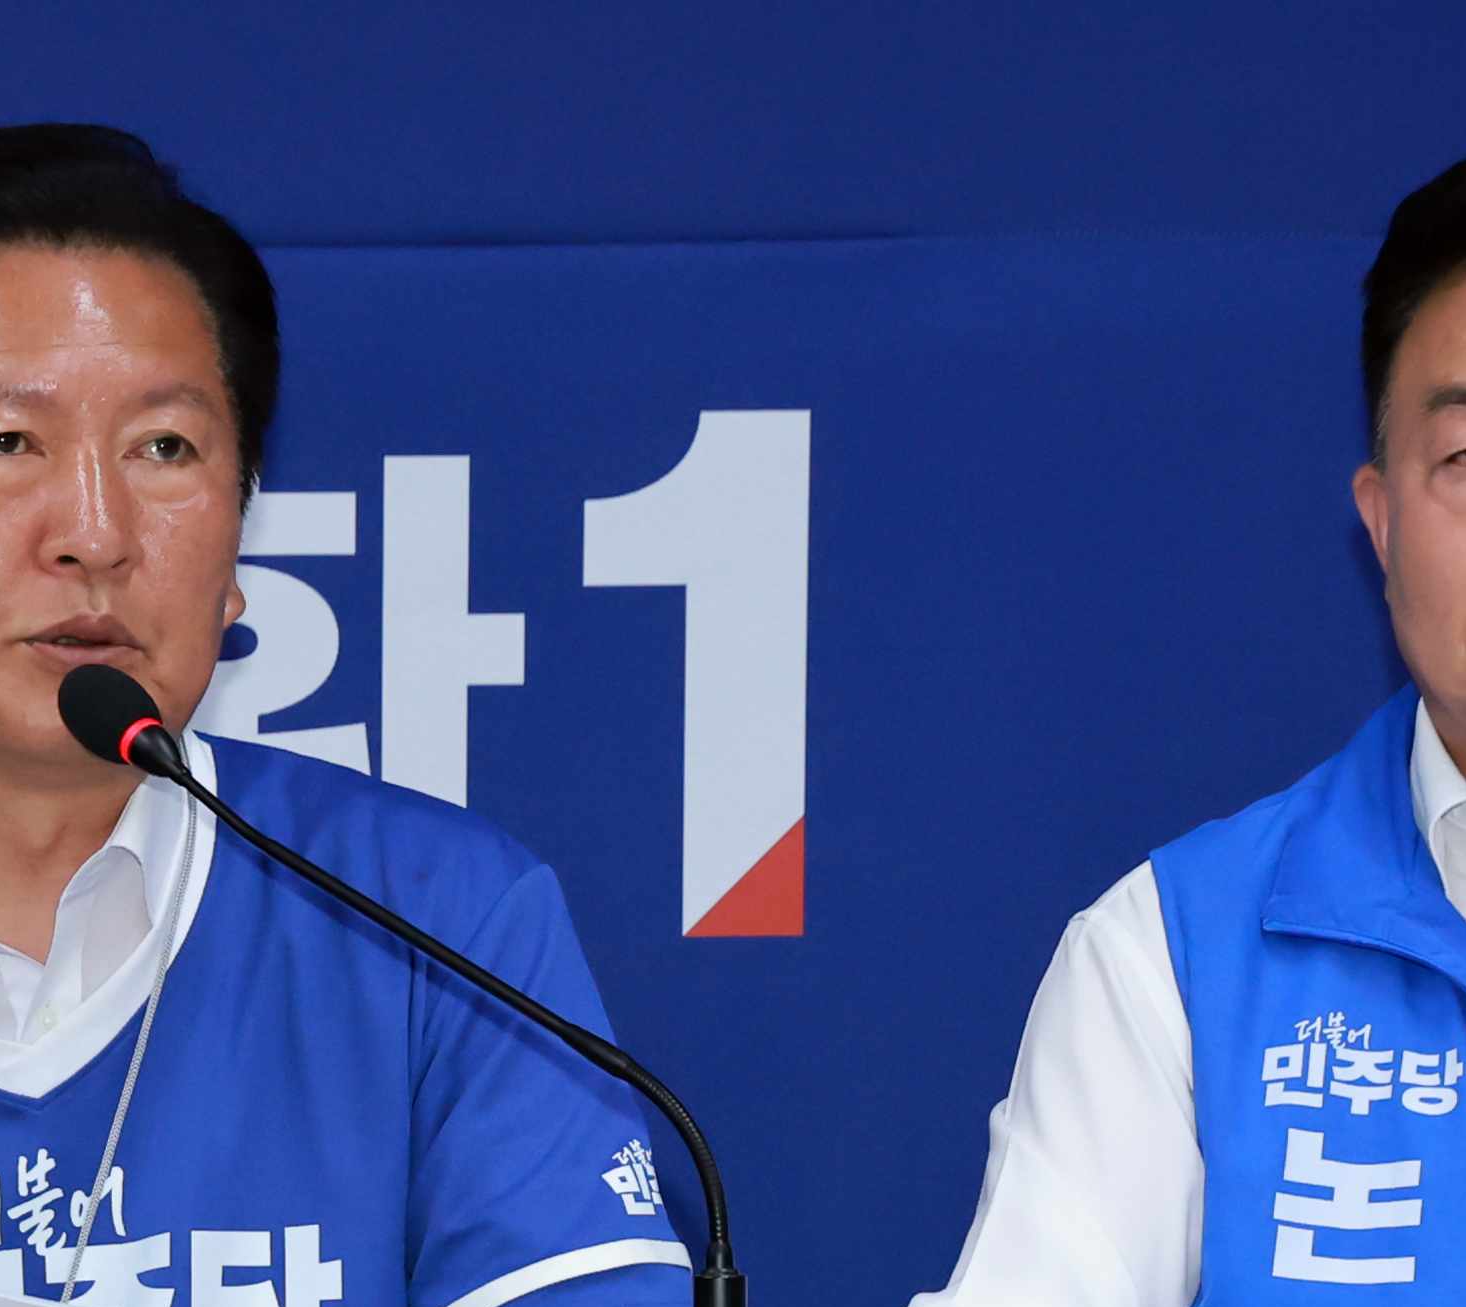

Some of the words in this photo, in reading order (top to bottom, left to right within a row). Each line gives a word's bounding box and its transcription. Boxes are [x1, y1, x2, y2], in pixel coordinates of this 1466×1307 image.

[582, 408, 812, 937] 1
[1294, 1012, 1372, 1050] 더불어
[1261, 1041, 1464, 1117] 민주당
